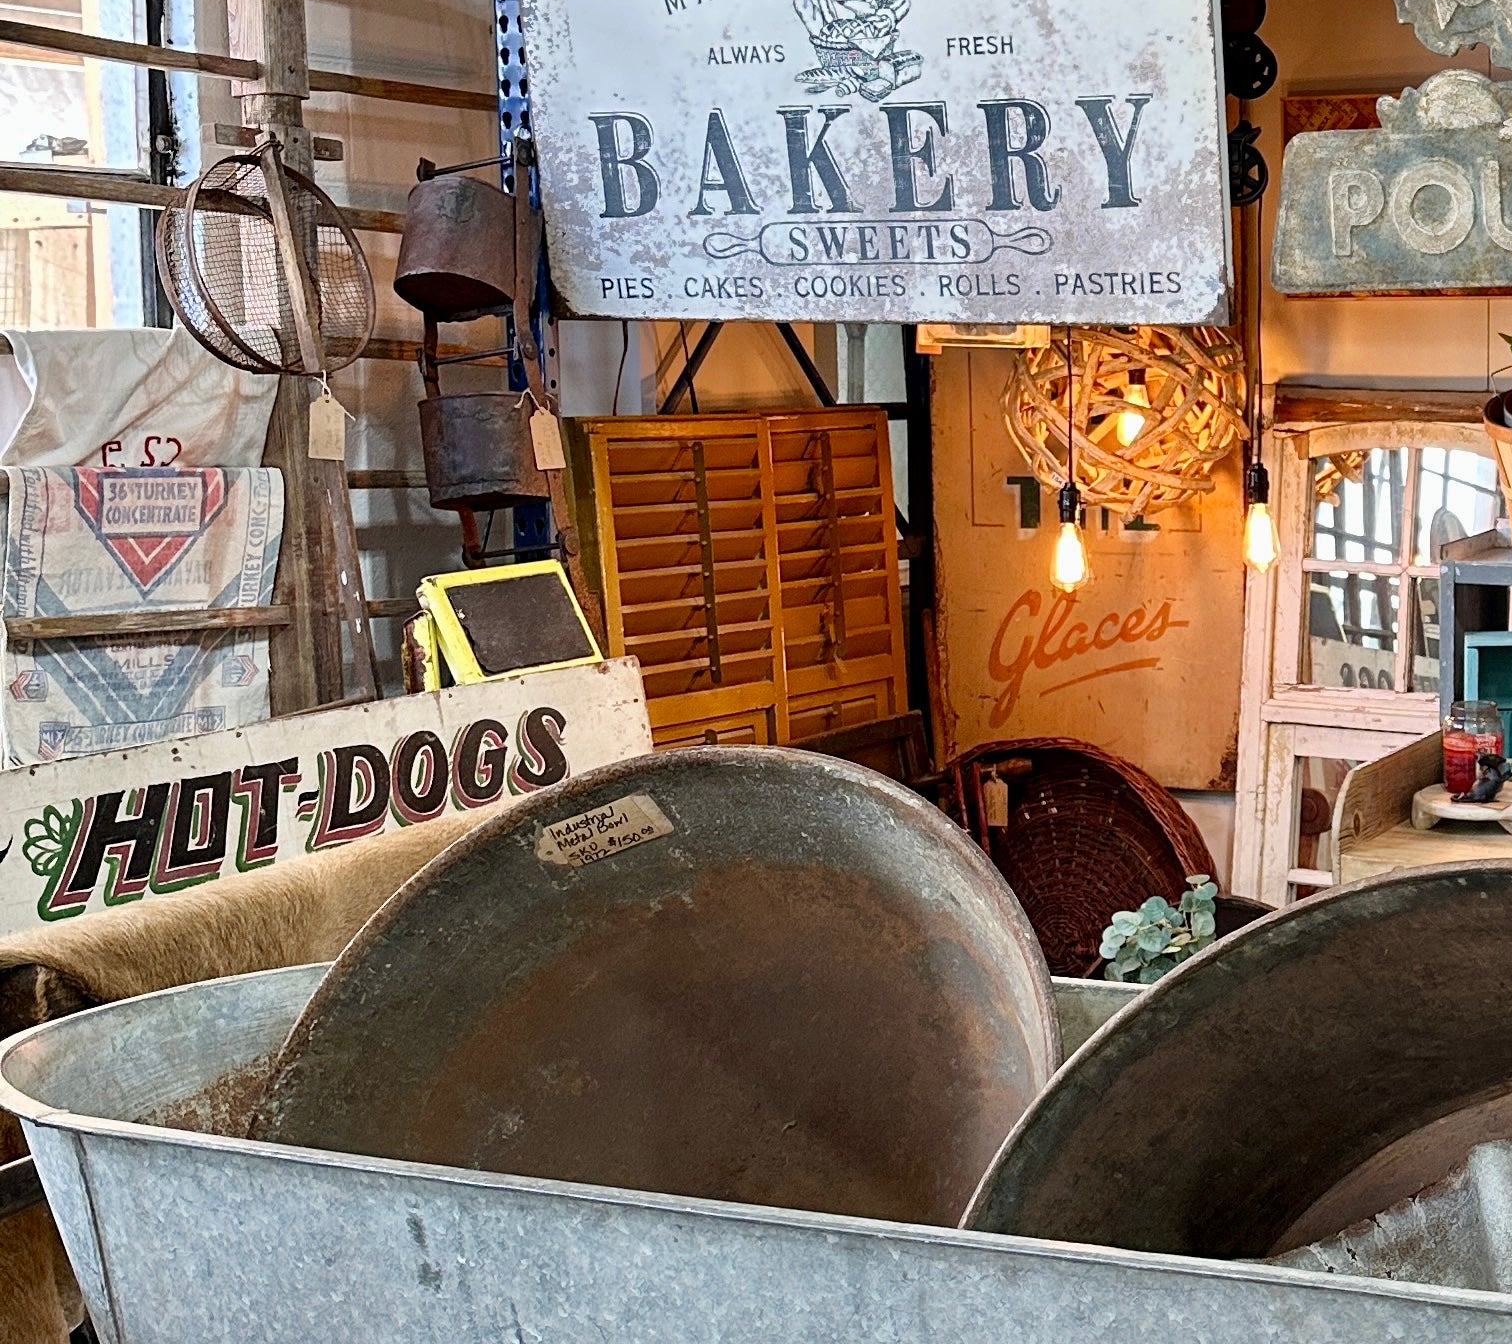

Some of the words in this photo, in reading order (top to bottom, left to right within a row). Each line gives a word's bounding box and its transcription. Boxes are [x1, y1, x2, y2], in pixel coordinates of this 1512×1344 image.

[706, 43, 786, 66] ALWAYS
[945, 34, 1015, 57] FRESH
[588, 93, 1154, 219] BAKERY
[787, 222, 974, 263] SWEETS
[601, 277, 655, 300] PIES
[683, 275, 764, 299] CAKES
[794, 273, 907, 298] COOKIES
[938, 272, 1021, 297] ROLLS
[1053, 270, 1183, 296] PASTRIES
[105, 505, 196, 525] CONCENTRATE
[238, 554, 262, 607] URKEY
[42, 706, 572, 918] HOT-DOGS
[550, 806, 615, 840] Industrial
[557, 827, 593, 852] Metal
[597, 813, 629, 834] Bowl
